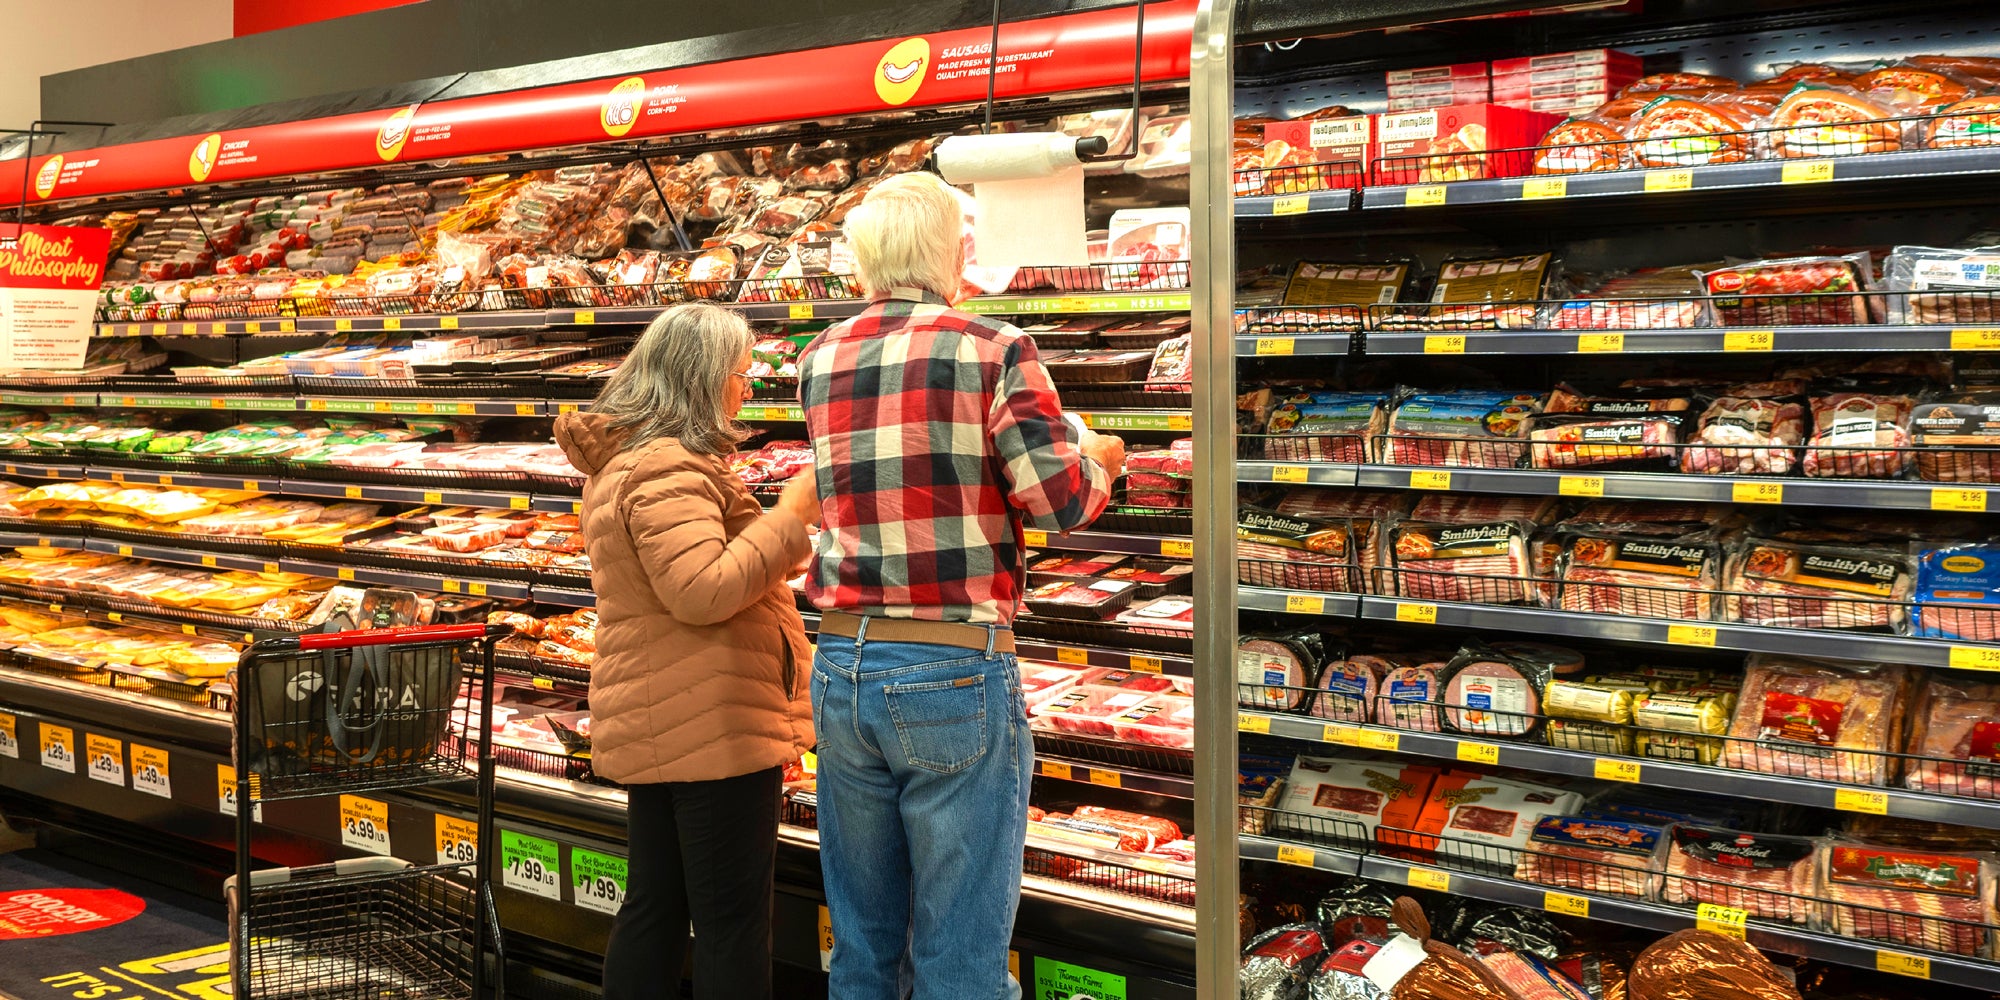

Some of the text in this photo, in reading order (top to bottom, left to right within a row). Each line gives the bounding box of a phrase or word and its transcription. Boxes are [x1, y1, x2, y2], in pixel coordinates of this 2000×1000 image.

[937, 50, 1054, 70] MADE FRESH WH RESTAURANT
[936, 64, 1016, 80] QUALITY INGREIENTS
[653, 84, 678, 96] PORK
[649, 96, 687, 106] ALL NATURAL
[647, 105, 677, 115] CORN-FED
[1399, 116, 1434, 128] Jimmy Dean
[223, 140, 249, 151] CHICKEN
[19, 231, 73, 259] Meat
[0, 251, 98, 285] Philosophy
[1961, 263, 1985, 272] SUGAR
[1717, 276, 1742, 289] Tyson
[1965, 272, 1980, 280] FREE
[1018, 298, 1164, 311] NOSH NOSH
[1446, 337, 1461, 346] 5.99
[1592, 402, 1649, 412] Smithfield
[1099, 417, 1132, 426] NOSH
[1584, 425, 1642, 442] Smithfield
[1440, 526, 1510, 542] Smithfield
[1622, 542, 1704, 559] Smithfield
[1805, 556, 1895, 577] Smithfield
[1935, 575, 1988, 584] Turkey Bacon
[1418, 606, 1433, 616] 5.99
[363, 627, 394, 635] GROCERY
[1694, 629, 1712, 639] 5.99
[1982, 651, 1999, 662] 3.29
[457, 834, 470, 842] PORK
[442, 838, 474, 862] $2.69
[1707, 841, 1771, 858] Black Label
[575, 863, 583, 871] TRI
[593, 868, 613, 880] SIRLOIN
[8, 893, 111, 924] GROCERY
[1708, 906, 1743, 924] 6.97
[39, 972, 123, 999] IT'S
[1082, 974, 1103, 989] Farms
[1040, 977, 1054, 988] 93%
[1055, 981, 1073, 992] LEAN
[1074, 985, 1103, 1000] GROUND
